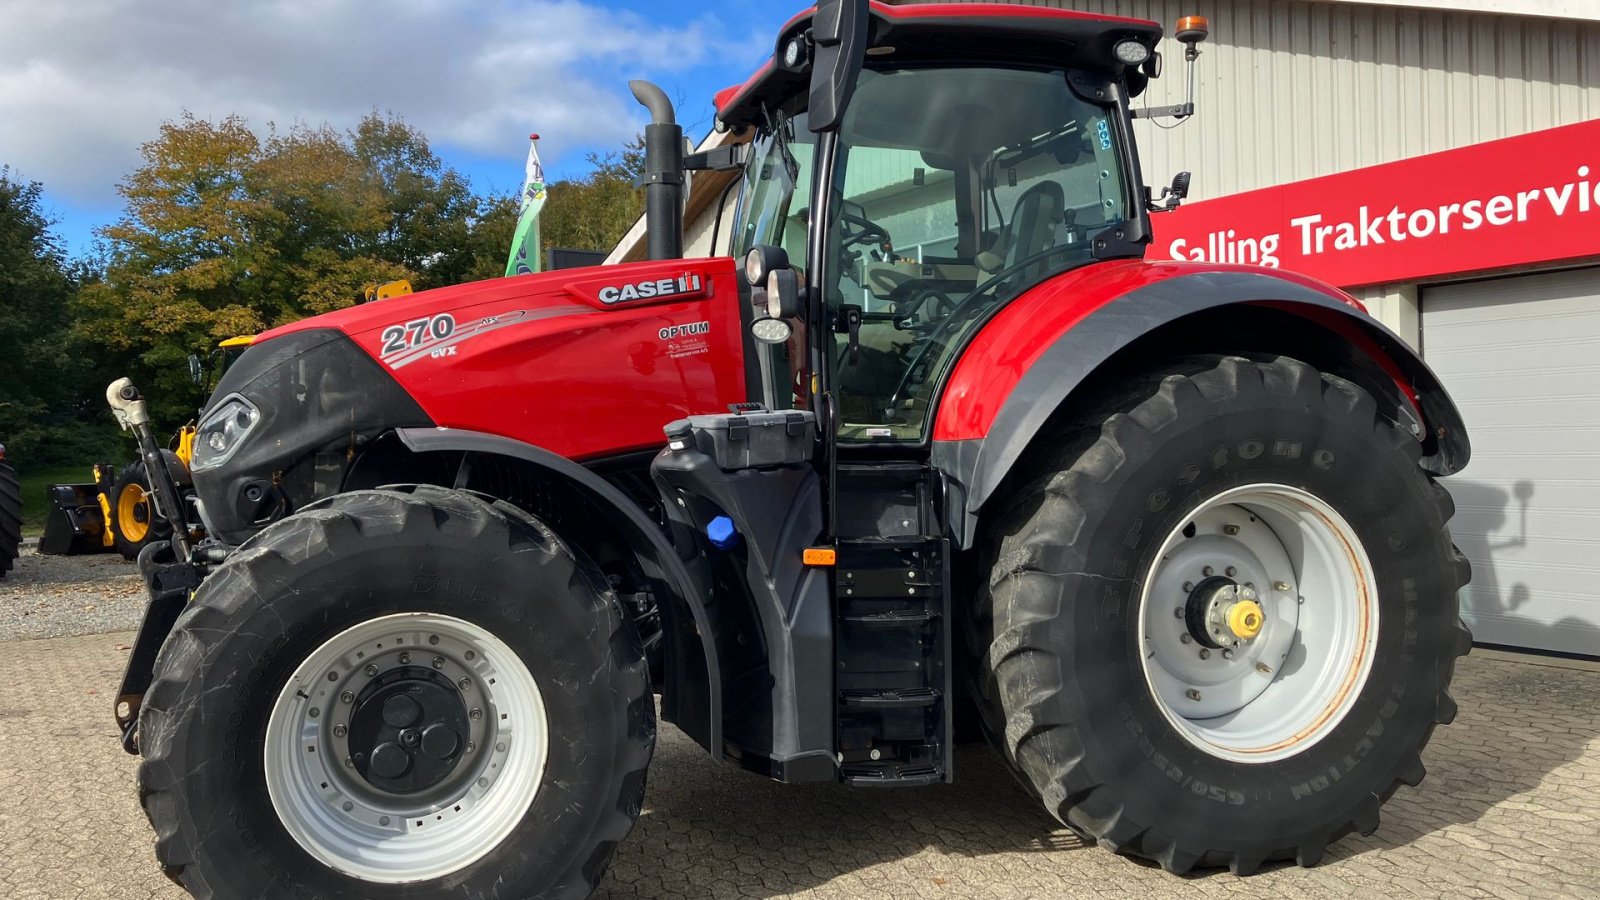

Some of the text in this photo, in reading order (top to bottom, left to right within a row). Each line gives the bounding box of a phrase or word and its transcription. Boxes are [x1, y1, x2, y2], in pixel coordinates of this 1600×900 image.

[1169, 229, 1280, 270] Salling
[598, 278, 675, 304] CASE
[380, 312, 456, 357] 270
[658, 320, 710, 340] OPTUM
